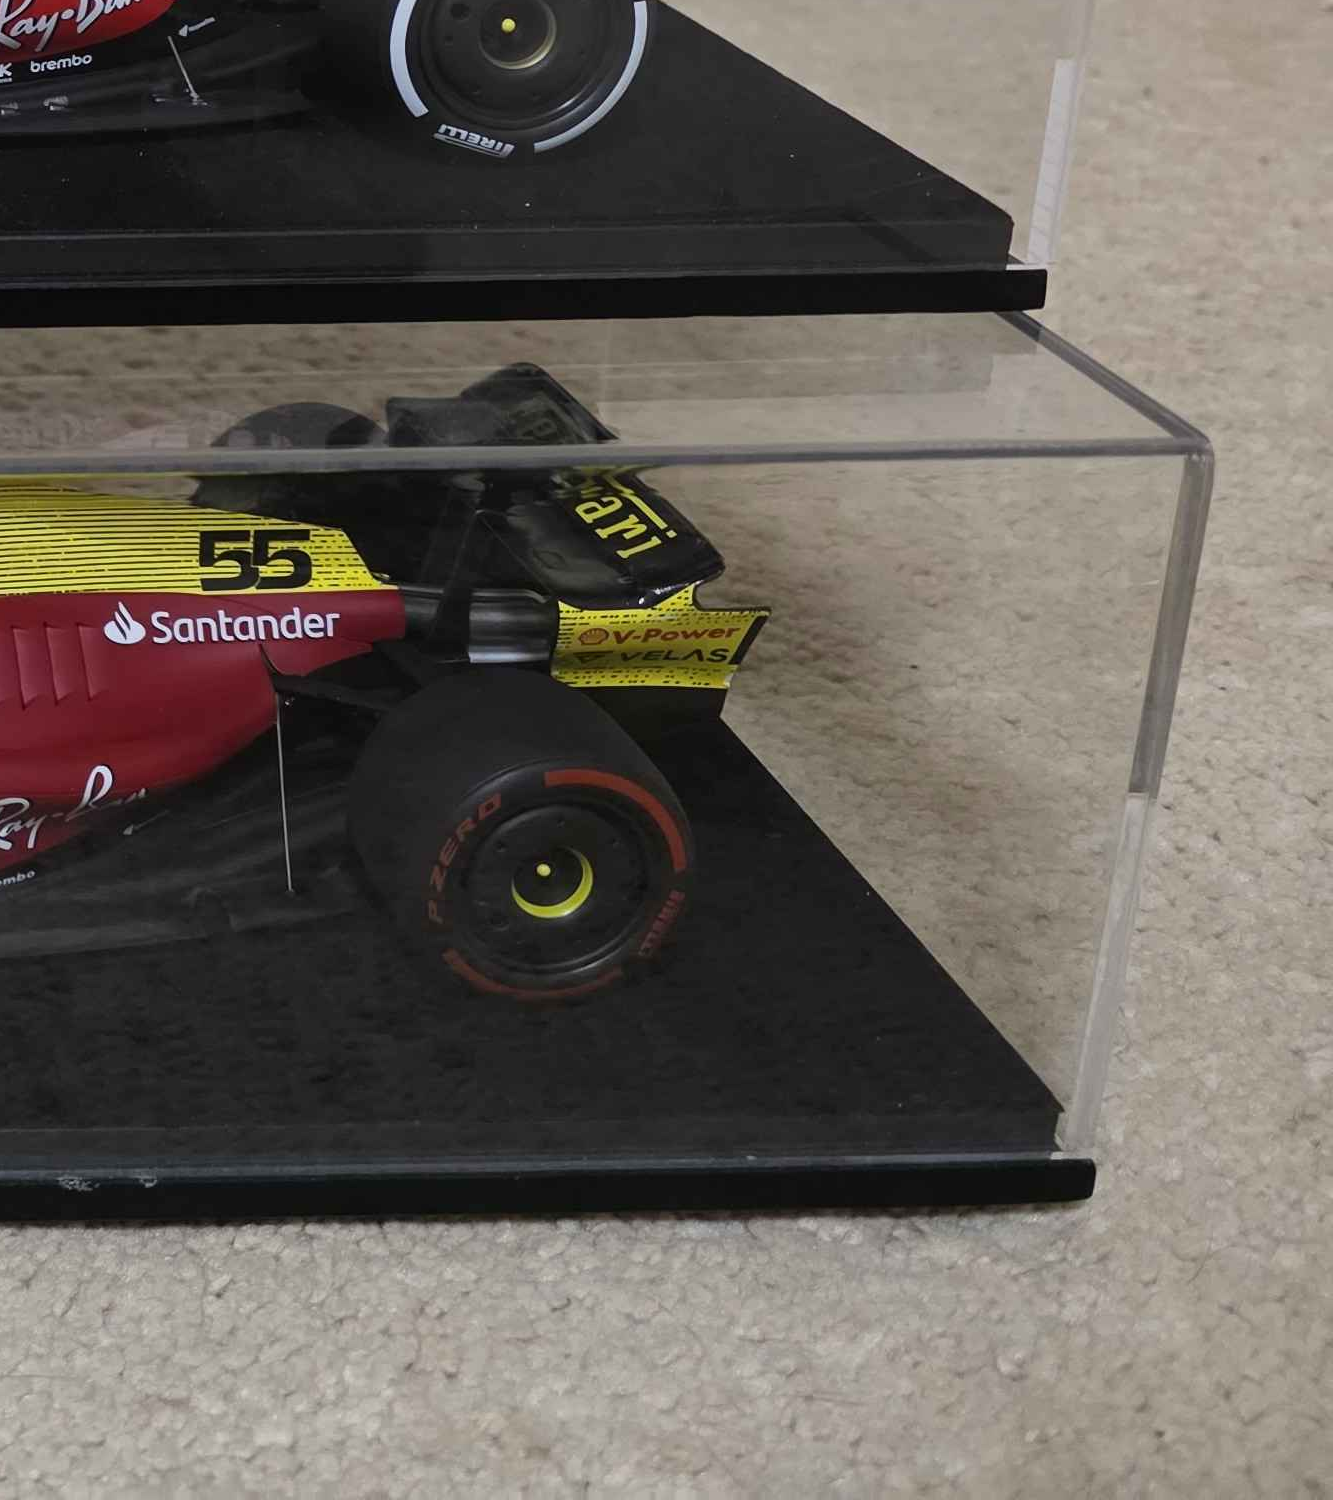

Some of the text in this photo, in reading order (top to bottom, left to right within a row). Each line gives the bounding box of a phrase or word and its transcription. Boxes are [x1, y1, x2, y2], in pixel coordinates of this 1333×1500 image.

[30, 51, 94, 74] brembo
[198, 529, 314, 591] 55
[150, 608, 340, 644] Santander
[612, 624, 740, 647] V-Power
[620, 647, 730, 664] VELAS
